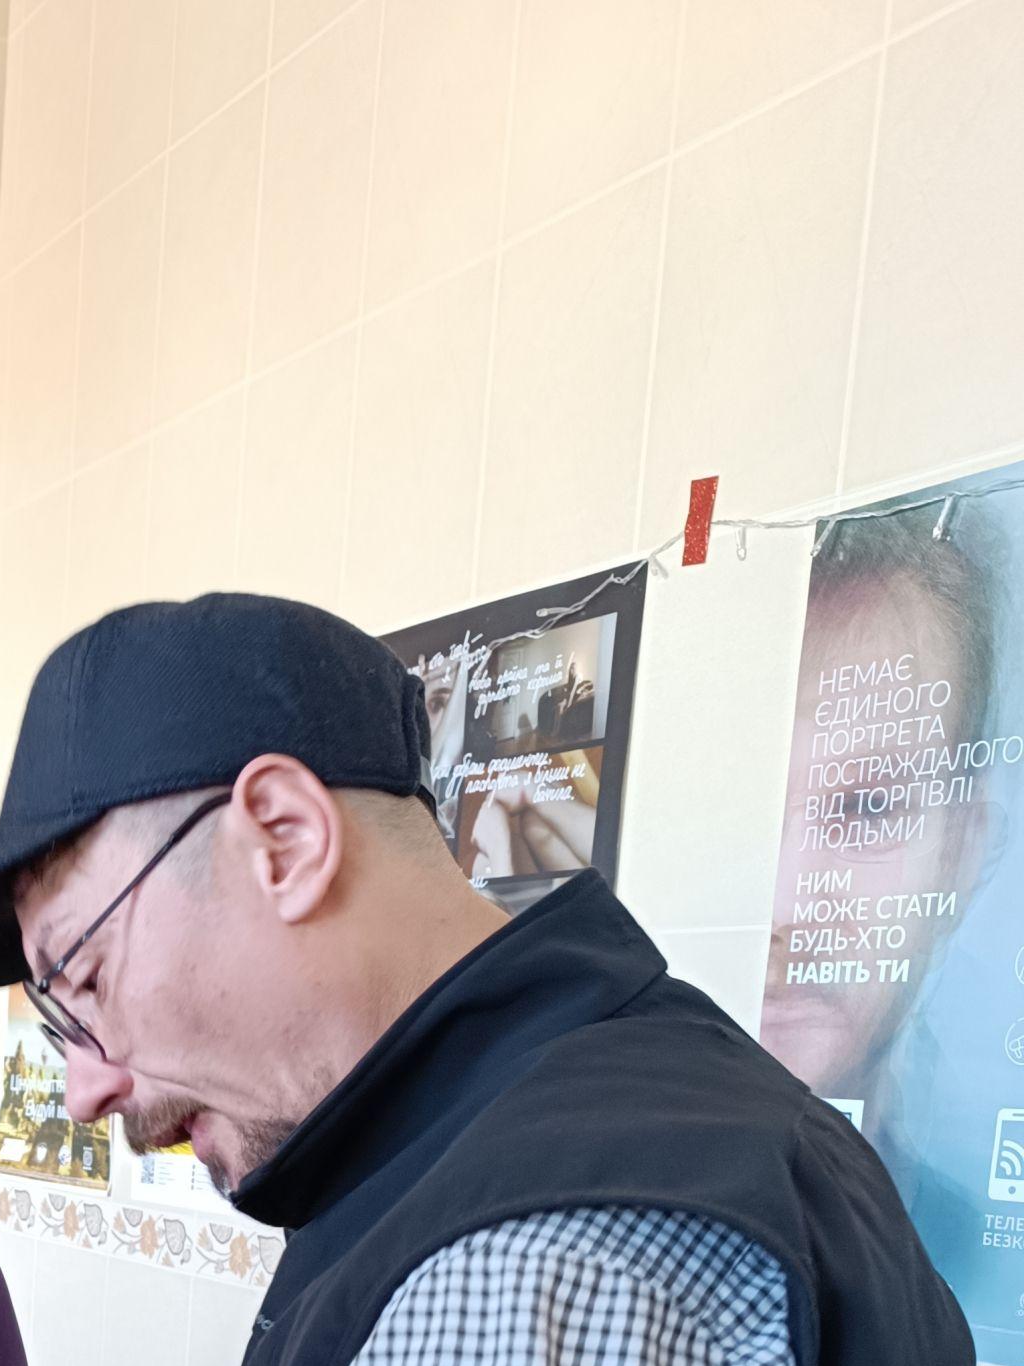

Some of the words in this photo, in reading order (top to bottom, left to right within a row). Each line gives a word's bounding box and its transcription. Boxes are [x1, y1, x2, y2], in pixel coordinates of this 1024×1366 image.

[818, 653, 914, 695] НЕМАЄ
[815, 680, 952, 730] ЄДИНОГО
[812, 714, 946, 758] ПОРТРЕТА
[808, 735, 1024, 789] ПОСТРАЖДАЛОГО
[805, 791, 846, 823] ВІД
[854, 775, 974, 815] ТОРГІВЛІ
[799, 814, 925, 853] ЛЮДЬМИ
[795, 869, 853, 895] НИМ
[792, 897, 871, 924] МОЖЕ
[876, 891, 957, 919] СТАТИ
[789, 925, 906, 956] БУДЬ-ХТО
[786, 960, 870, 984] НАВІТЬ
[876, 959, 910, 983] ТИ
[982, 1232, 1024, 1250] БЕЗК
